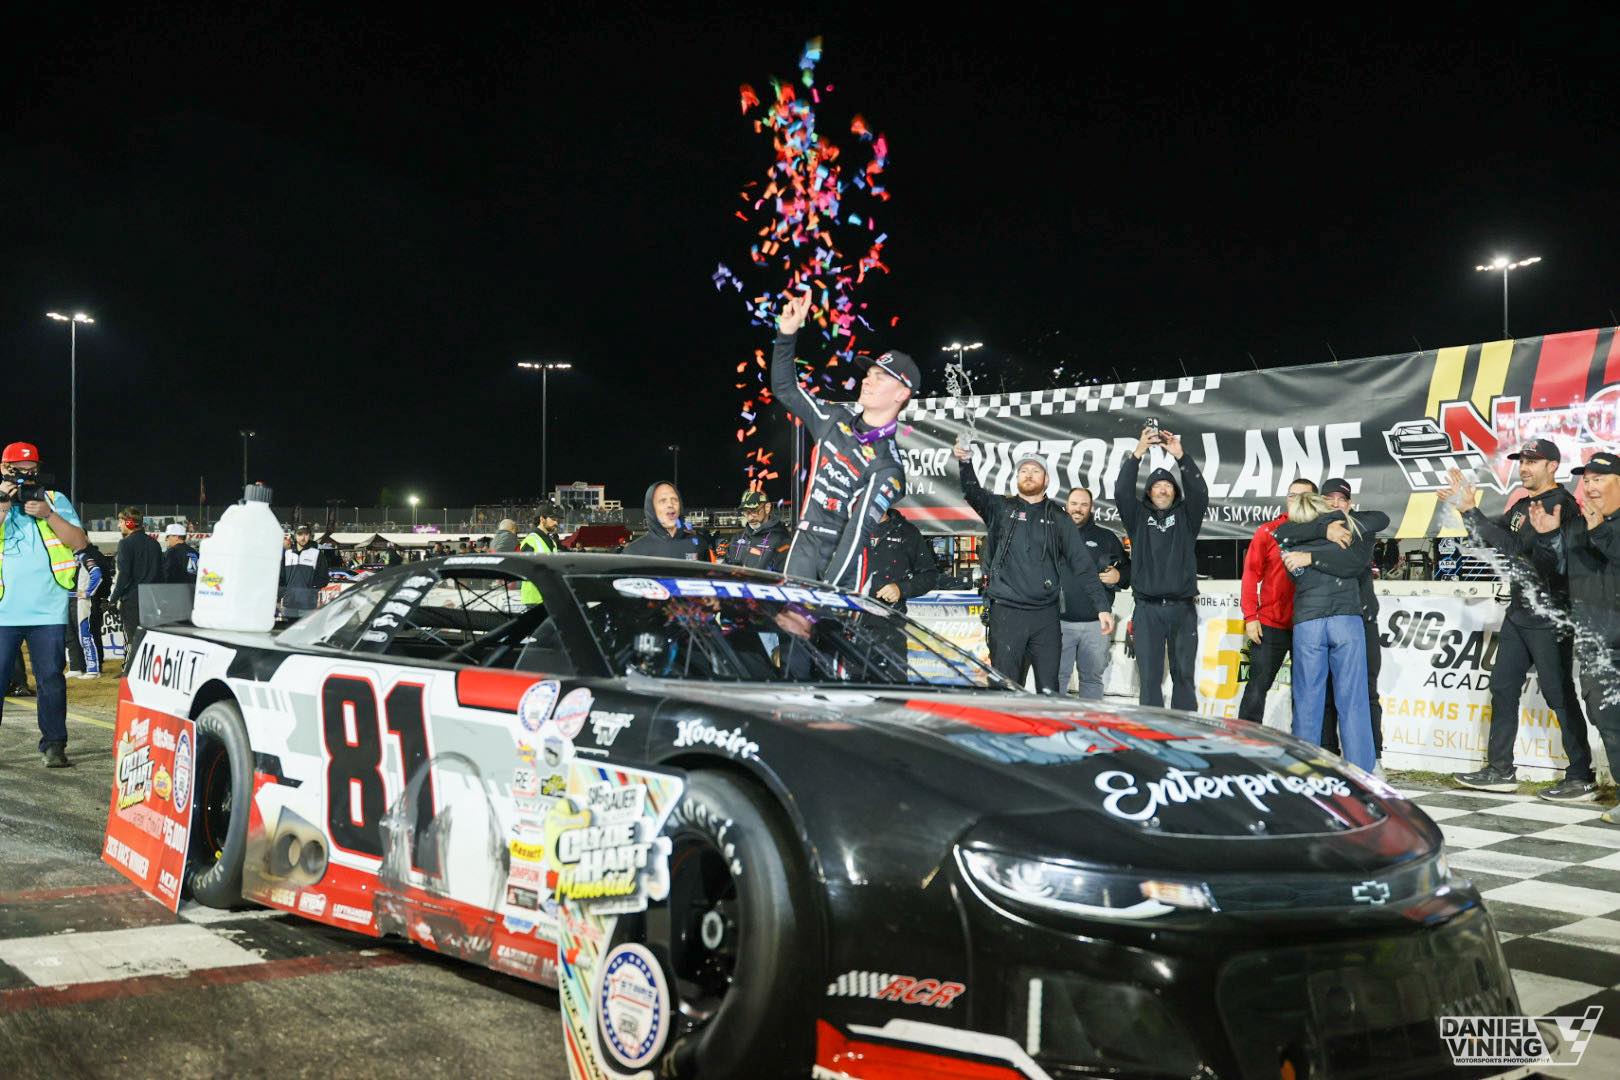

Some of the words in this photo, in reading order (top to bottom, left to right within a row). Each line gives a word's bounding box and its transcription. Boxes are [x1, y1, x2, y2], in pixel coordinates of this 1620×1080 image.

[900, 447, 951, 477] SCAR
[1202, 422, 1361, 498] LANE
[1224, 505, 1281, 522] SMYRNA
[676, 579, 848, 607] STARS
[1220, 599, 1231, 607] AT
[1380, 610, 1445, 650] SIG
[1431, 629, 1501, 671] SAU
[138, 643, 184, 691] Mobil
[1380, 698, 1459, 720] EARMS
[673, 718, 759, 759] Hoosier
[1392, 726, 1426, 746] ALL
[321, 673, 441, 878] 81
[556, 822, 636, 865] CLYDE
[575, 843, 652, 883] HART
[878, 976, 966, 1008] RCR
